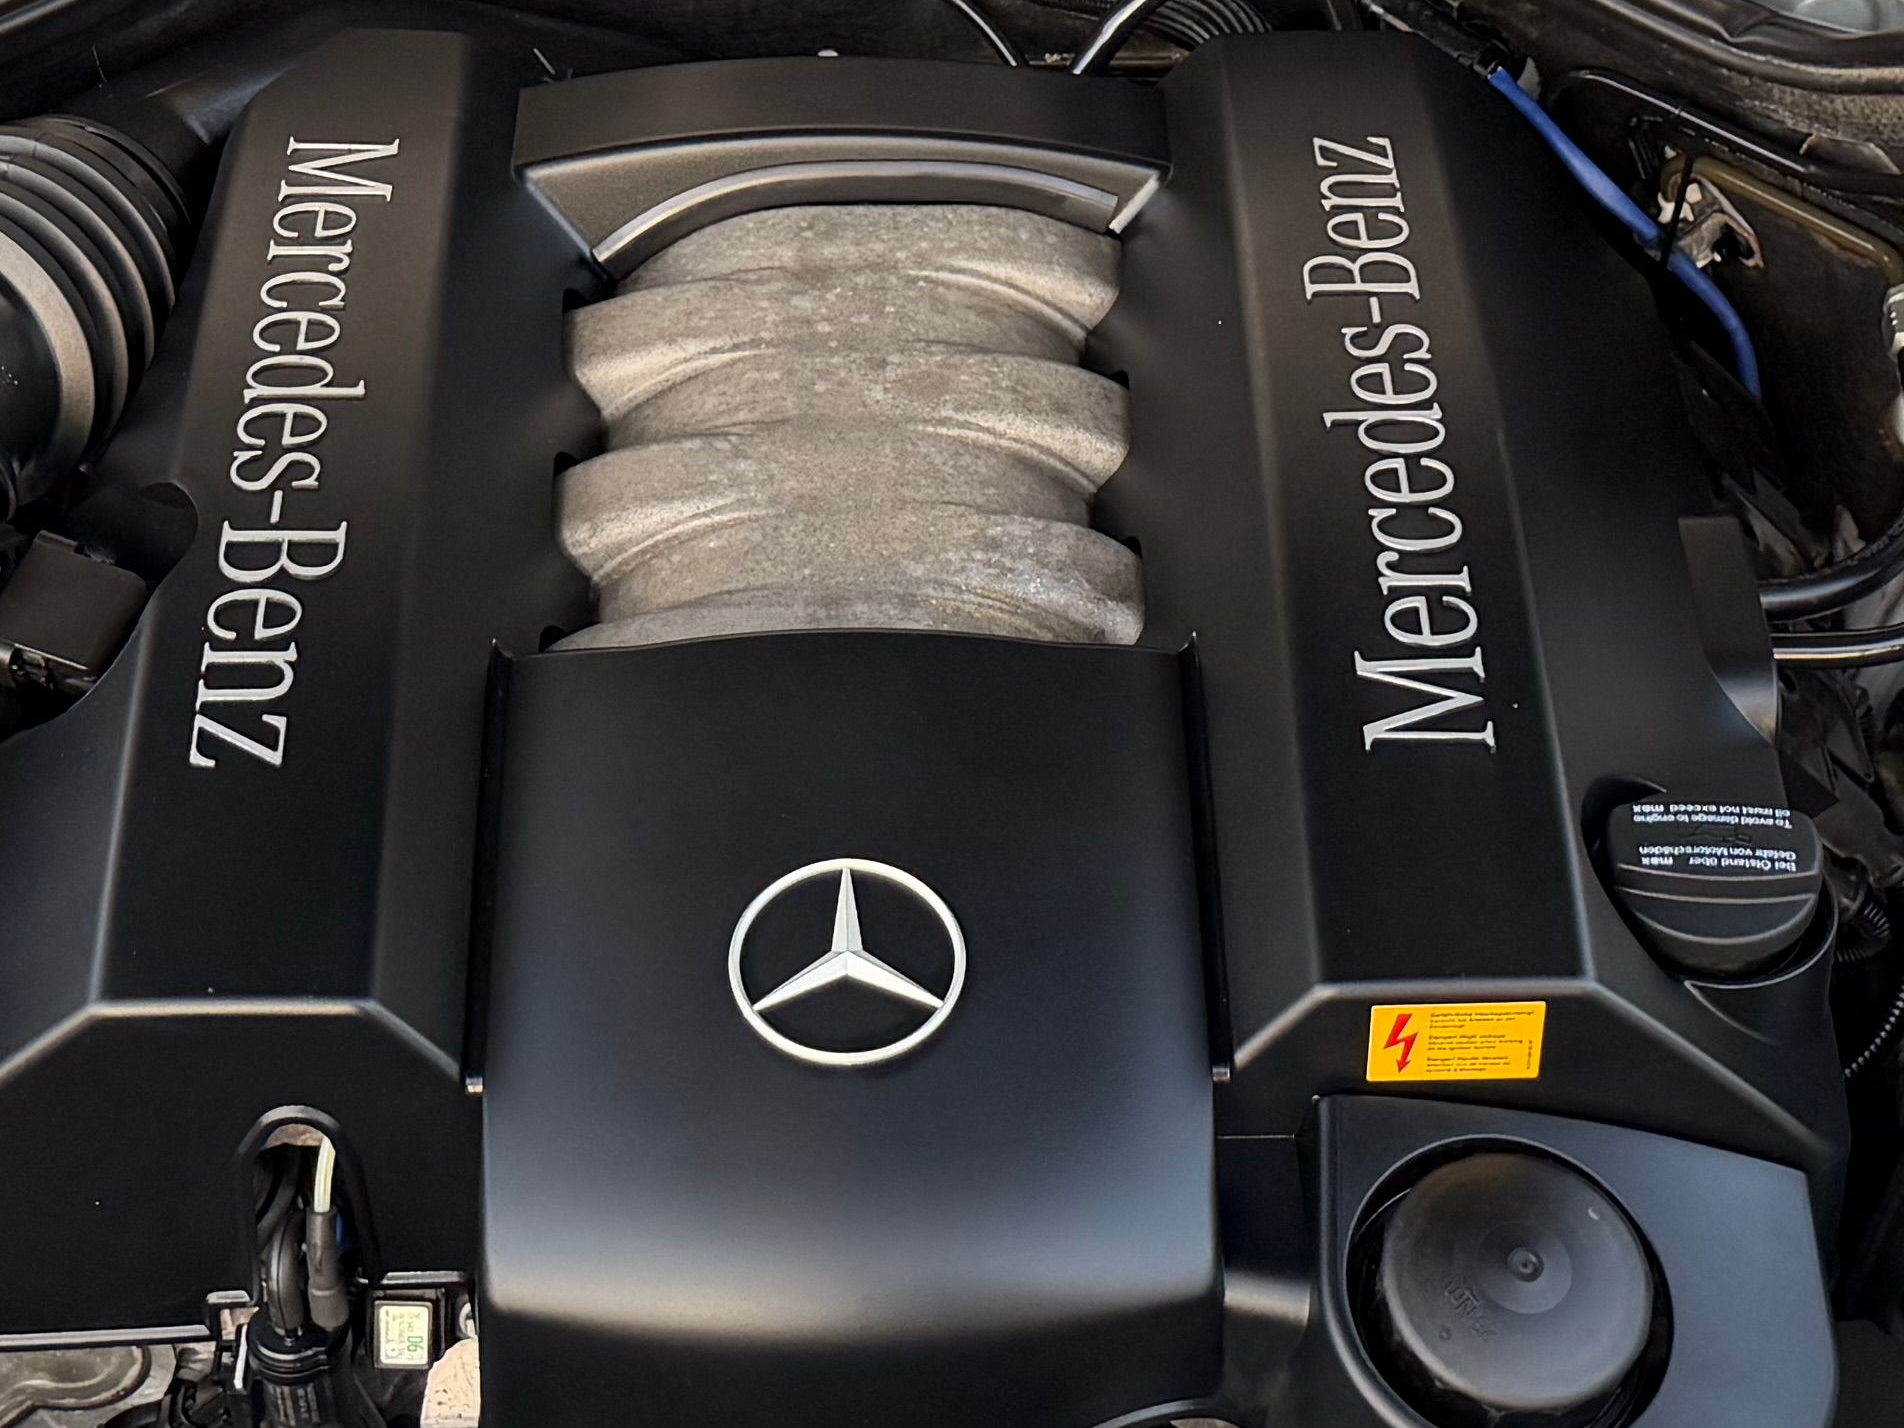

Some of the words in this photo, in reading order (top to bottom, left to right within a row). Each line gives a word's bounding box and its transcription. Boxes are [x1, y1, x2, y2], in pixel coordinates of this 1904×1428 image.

[189, 136, 401, 770] Mercedes-Benz
[1303, 136, 1496, 755] Mercedes-Benz
[1691, 813, 1739, 824] damage
[1729, 847, 1753, 856] von
